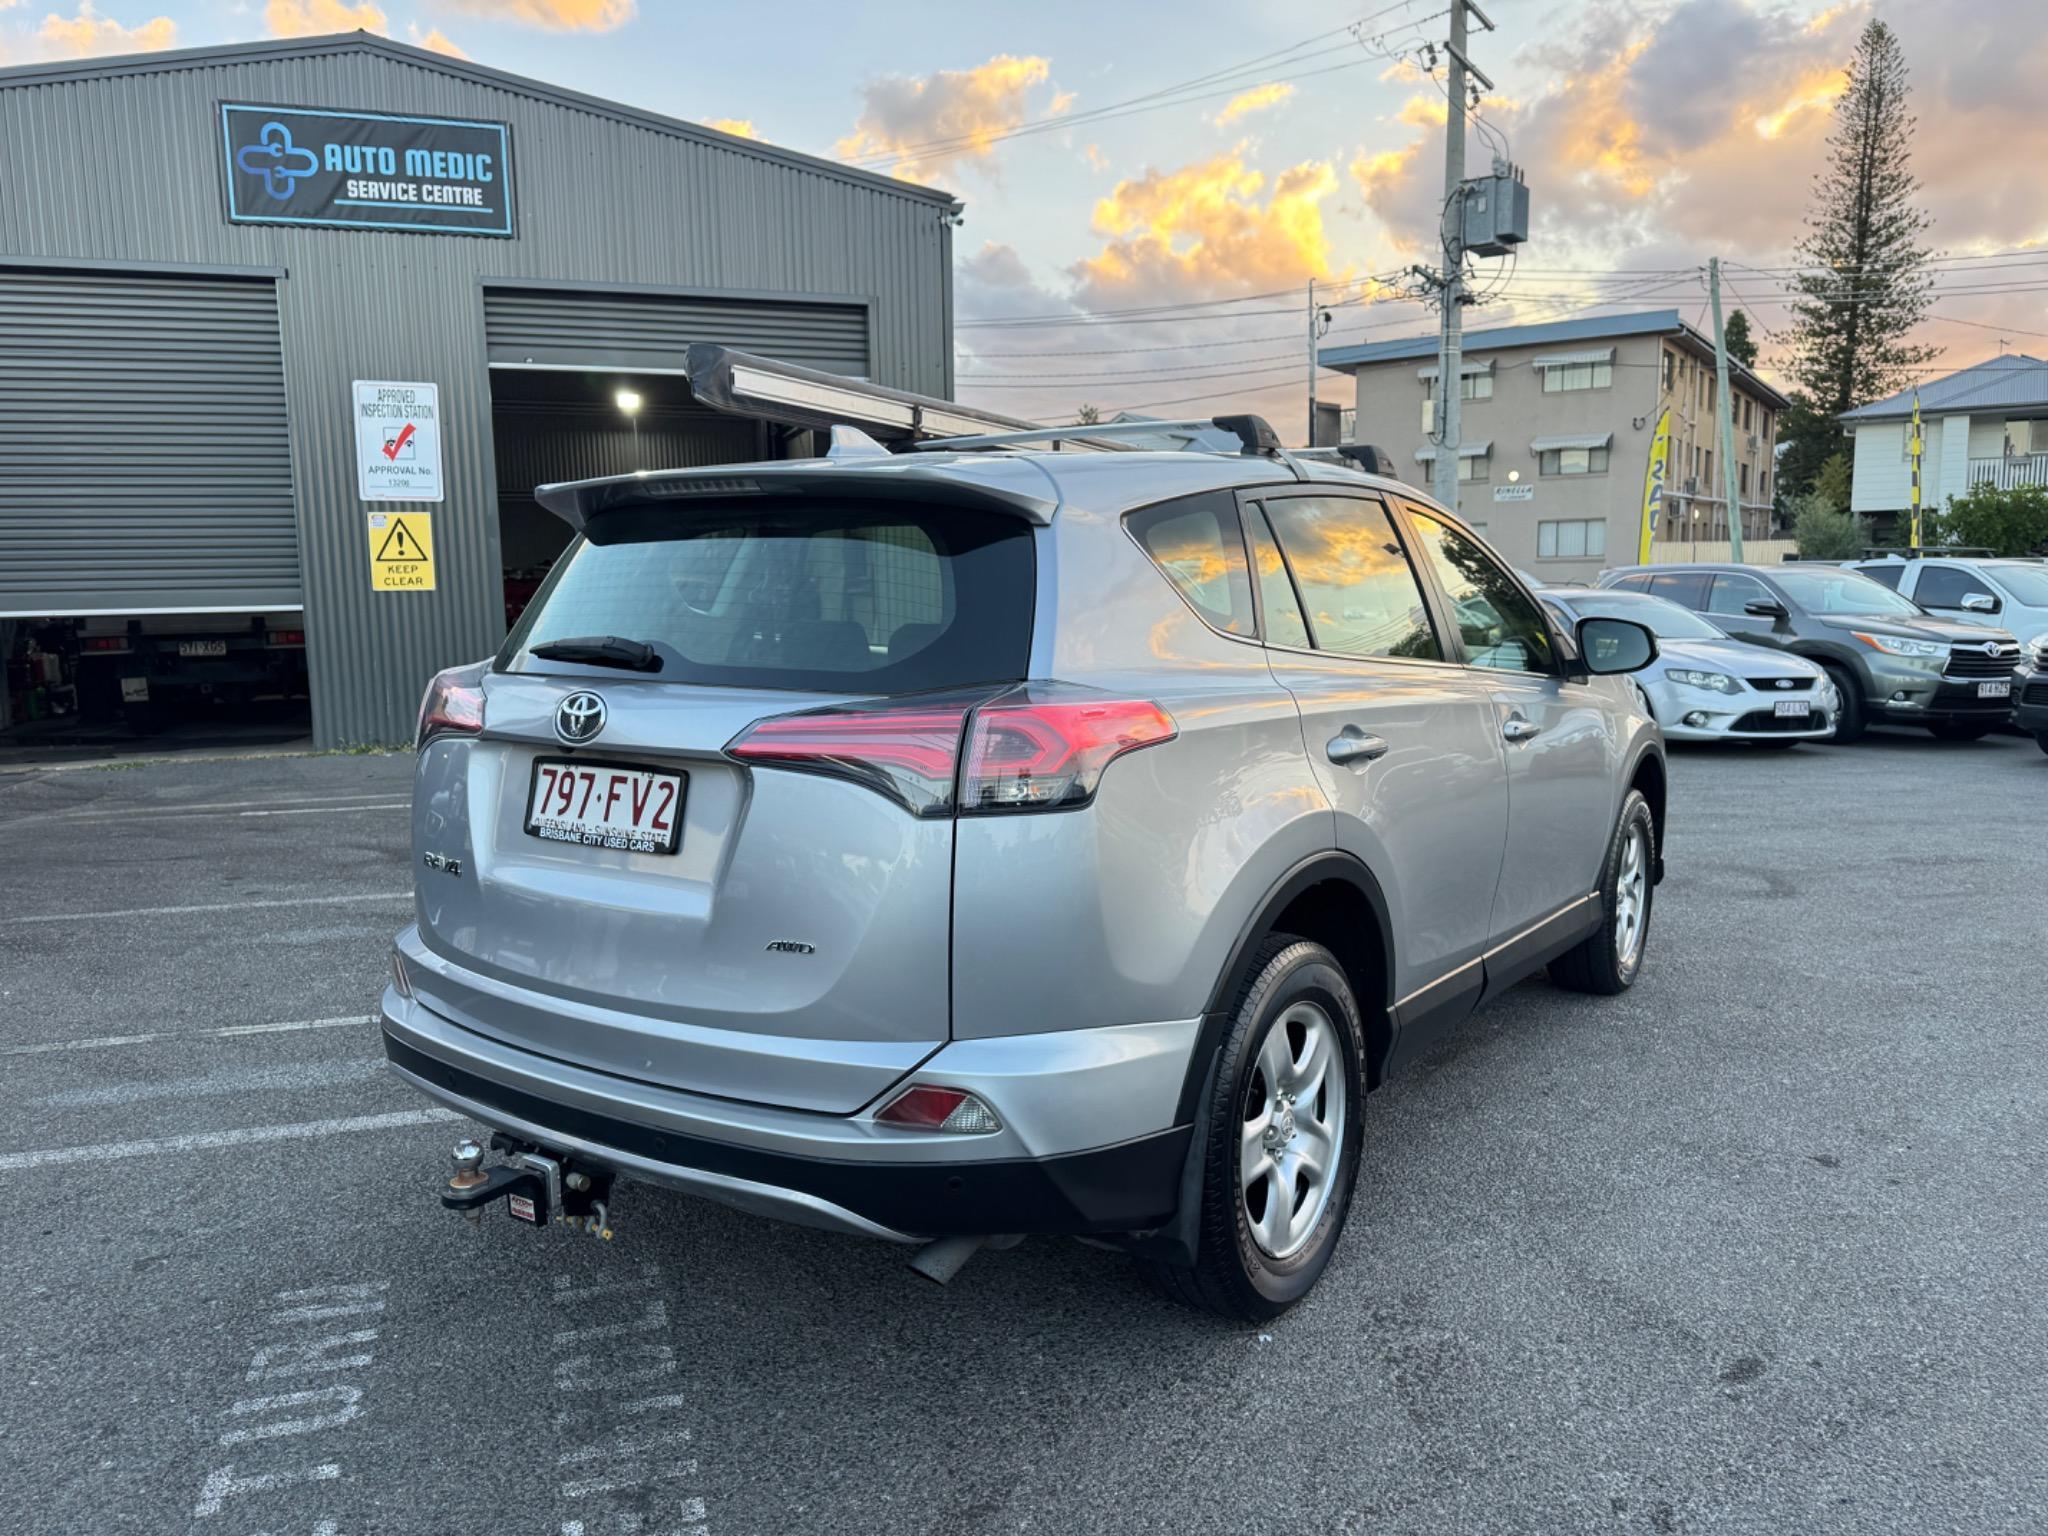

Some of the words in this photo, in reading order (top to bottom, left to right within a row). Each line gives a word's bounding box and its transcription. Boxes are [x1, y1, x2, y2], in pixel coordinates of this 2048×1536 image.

[324, 143, 396, 176] AUTO
[405, 148, 493, 182] MEDIC
[347, 179, 418, 202] SERVICE
[422, 184, 483, 206] CENTRE
[377, 388, 416, 404] APPROVED
[361, 403, 403, 418] INSPECTION
[404, 405, 434, 419] STATION
[368, 465, 416, 475] APPROVAL
[387, 564, 418, 574] KEEP
[383, 576, 424, 586] CLEAR
[540, 827, 582, 844] BRISBANE
[583, 833, 604, 846] CITY
[603, 836, 628, 849] USED
[629, 840, 655, 853] CARS
[765, 940, 816, 955] AWD
